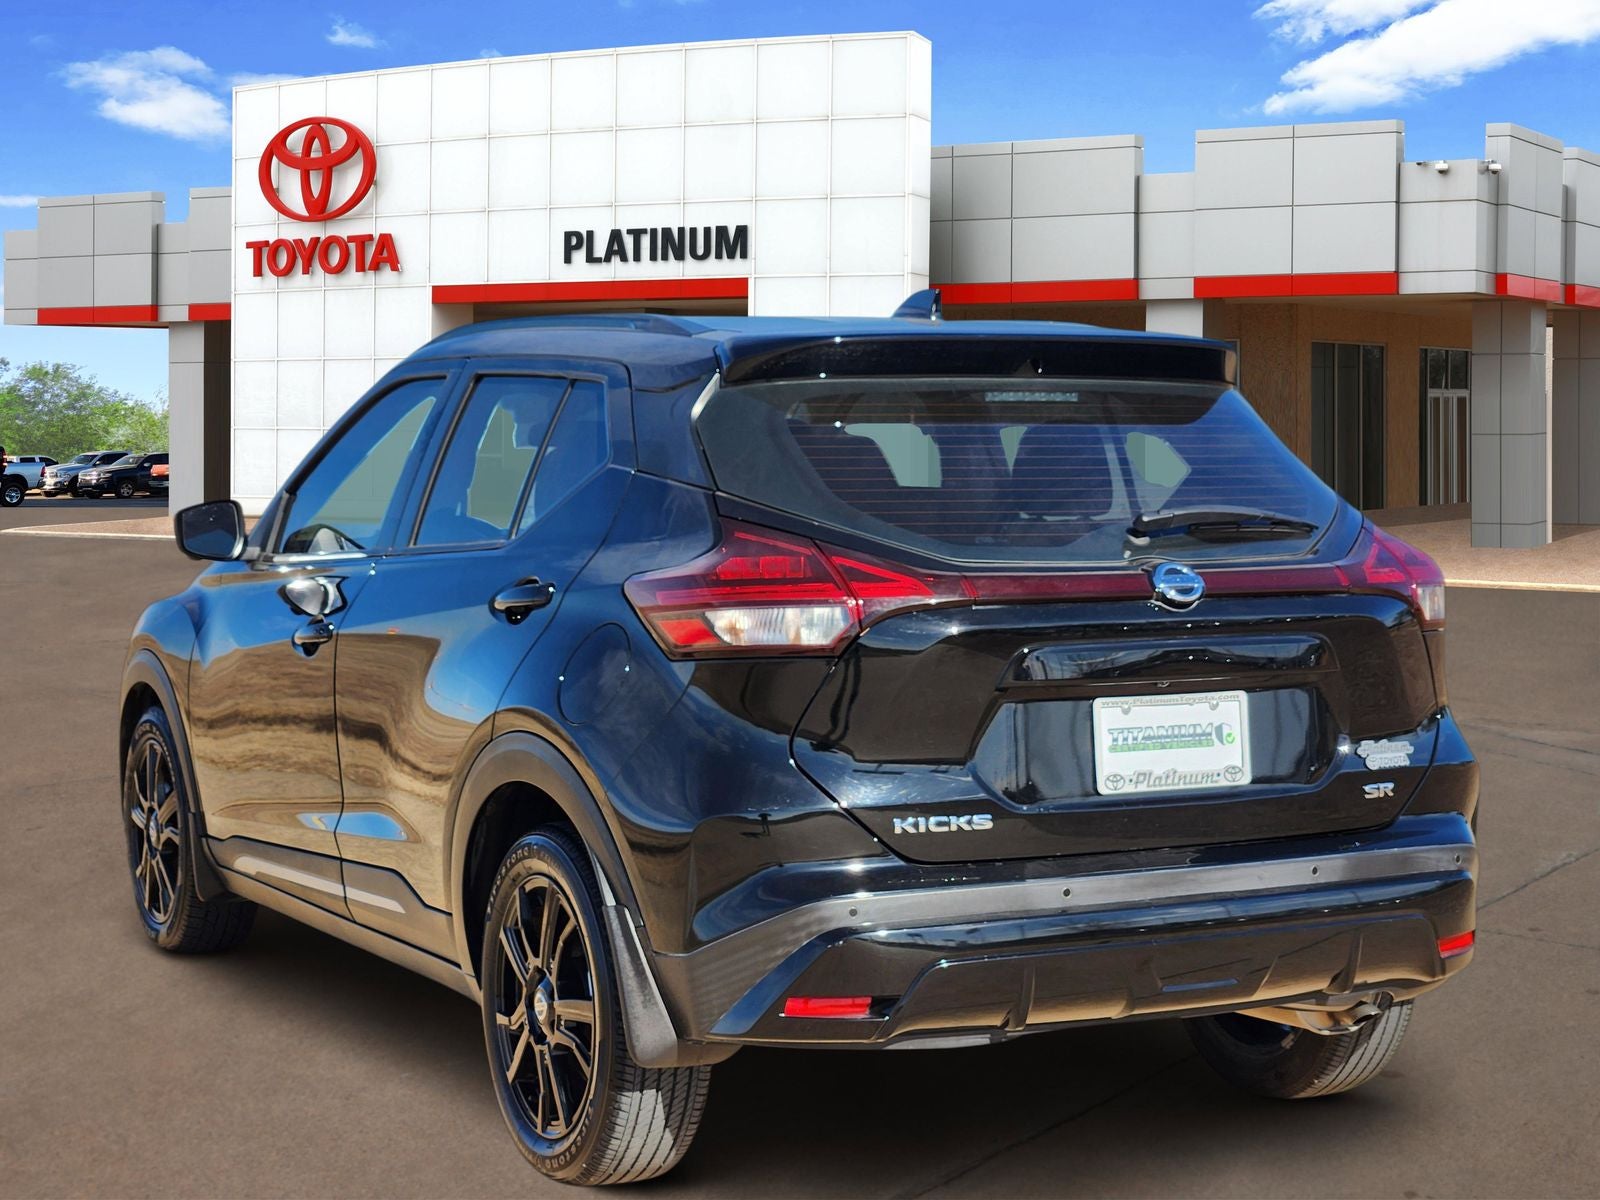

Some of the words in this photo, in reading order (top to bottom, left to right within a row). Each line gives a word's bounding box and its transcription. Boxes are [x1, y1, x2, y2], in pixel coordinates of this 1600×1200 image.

[246, 233, 401, 277] TOYOTA
[563, 225, 748, 264] PLATINUM
[1101, 693, 1240, 706] www.PlatinumToyota.com
[1107, 722, 1214, 745] TITANIUM
[1133, 768, 1217, 789] Platinum
[1362, 782, 1395, 799] SR
[892, 813, 994, 834] KICKS
